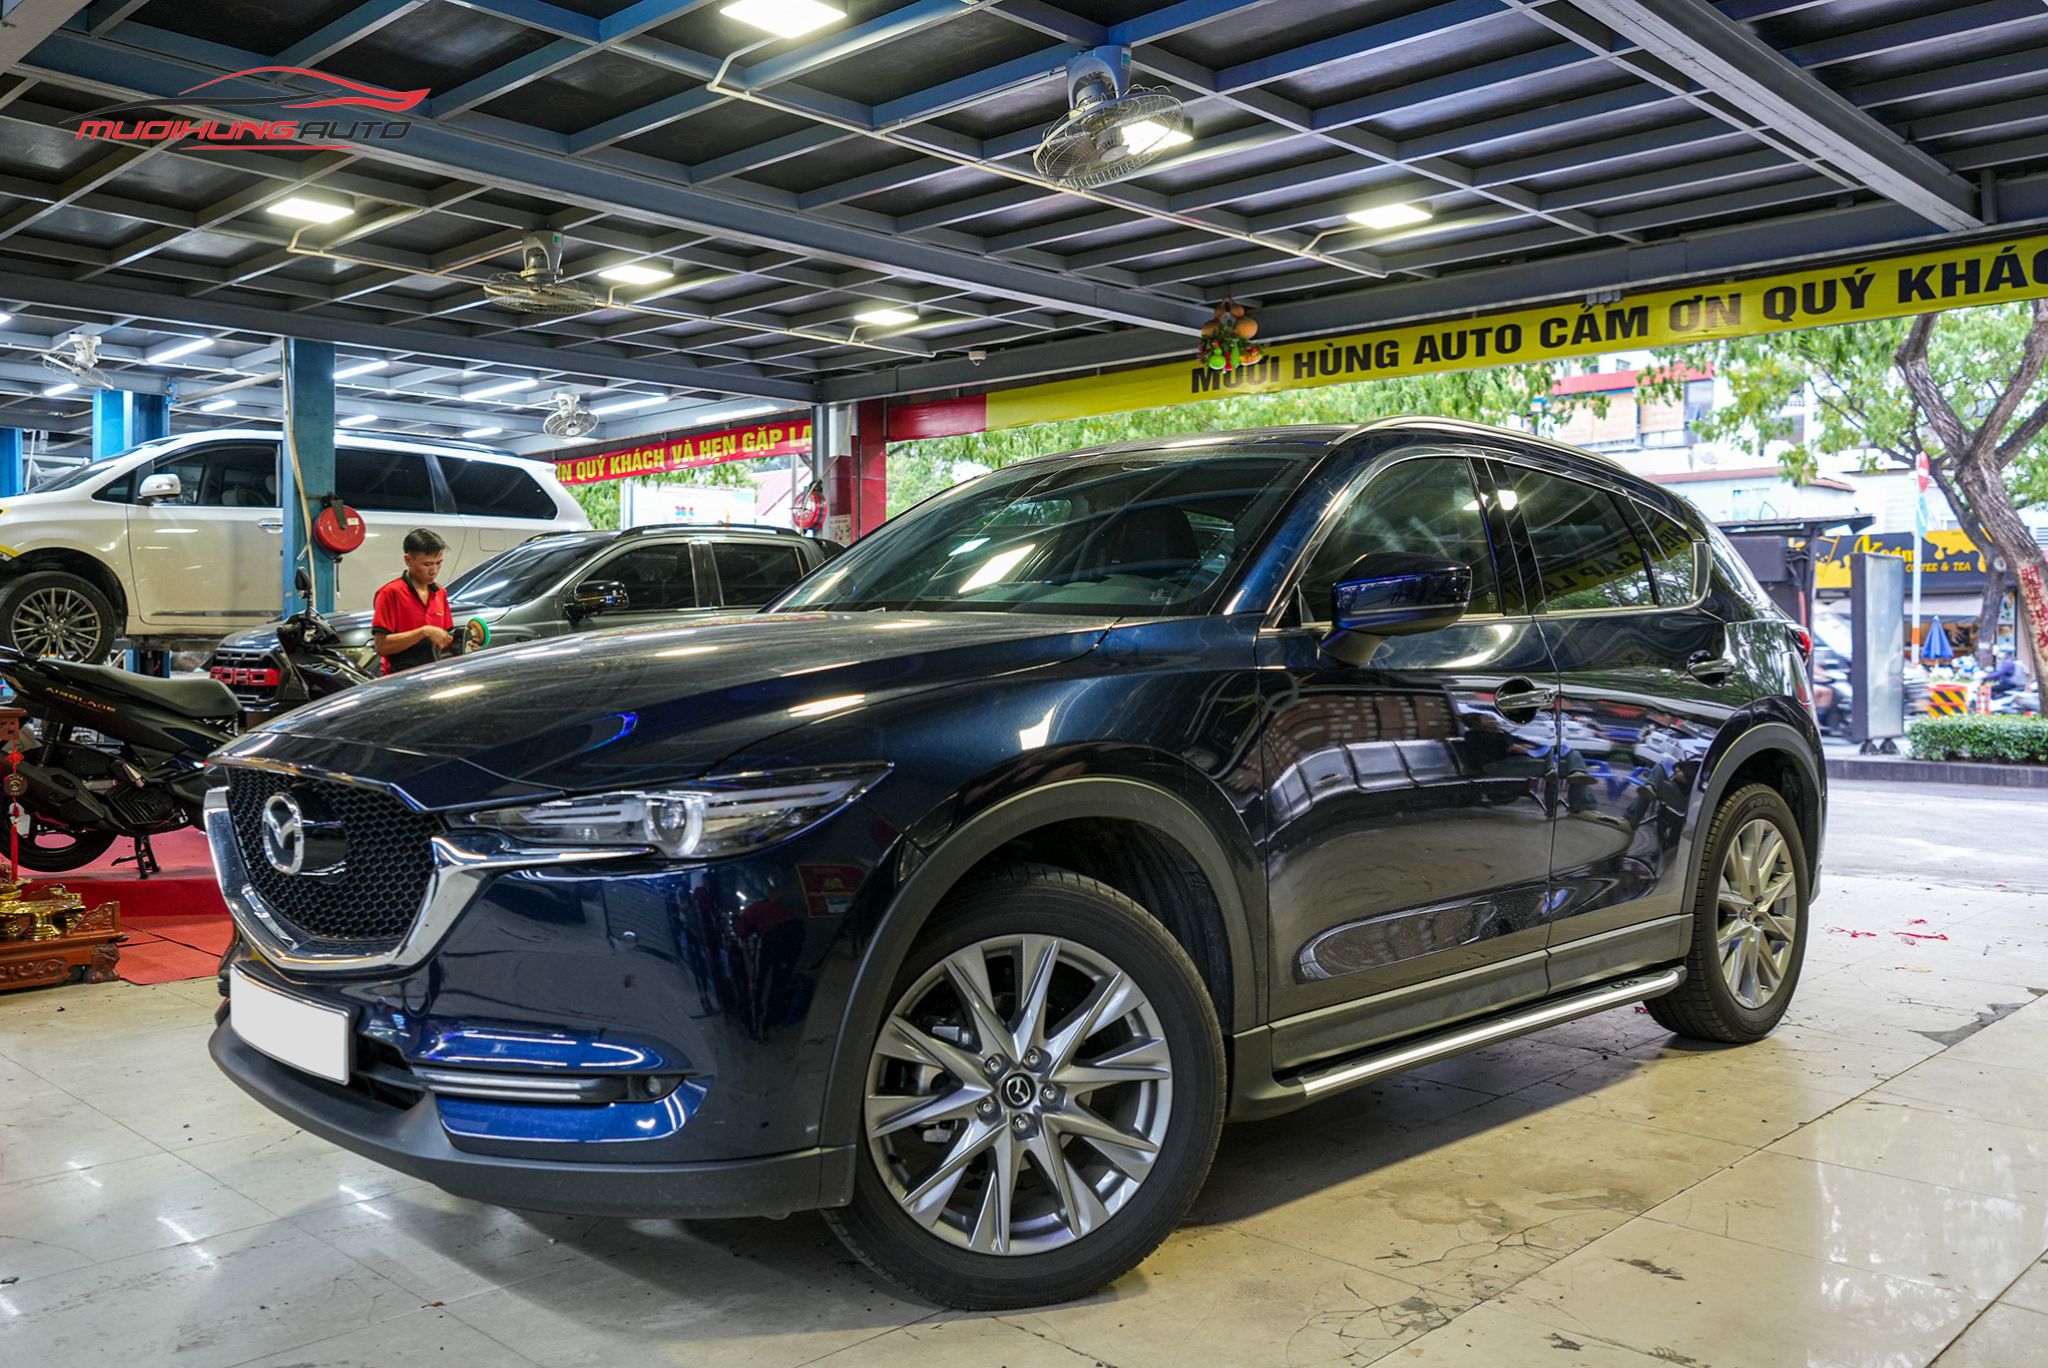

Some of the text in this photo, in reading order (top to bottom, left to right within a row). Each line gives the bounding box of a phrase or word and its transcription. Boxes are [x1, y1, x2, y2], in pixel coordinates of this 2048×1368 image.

[1293, 343, 1399, 379] HÙNG
[1413, 323, 1522, 365] AUTO
[1669, 293, 1741, 332] ƠN
[1763, 267, 1876, 323] QUÝ
[576, 454, 605, 481] QUÝ
[610, 447, 664, 475] KHÁCH
[671, 439, 694, 464] VÀ
[699, 434, 736, 461] HẸN
[742, 426, 783, 455] GẶP
[1953, 561, 1971, 572] TEA
[210, 666, 283, 686] FORD
